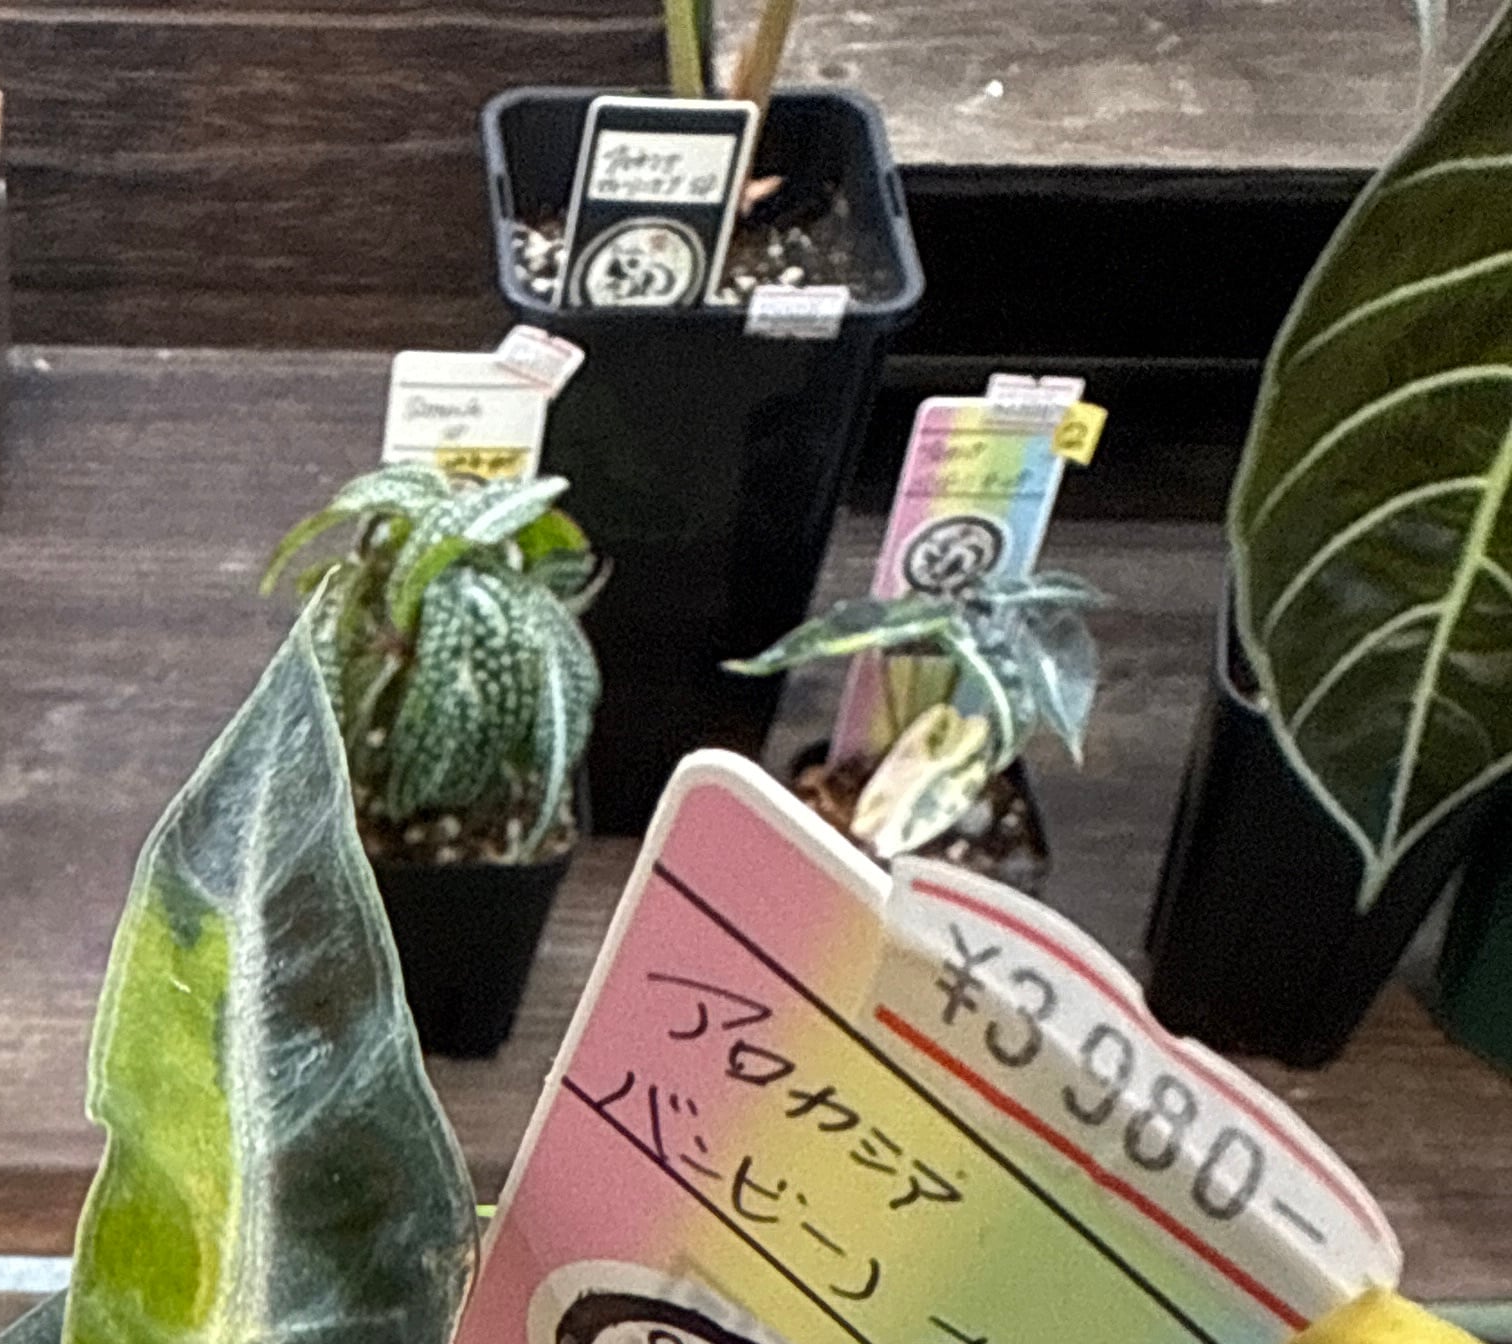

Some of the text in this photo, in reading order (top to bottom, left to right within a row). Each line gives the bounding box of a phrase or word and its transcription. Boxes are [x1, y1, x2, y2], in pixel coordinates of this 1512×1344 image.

[647, 971, 965, 1209] アロカシア
